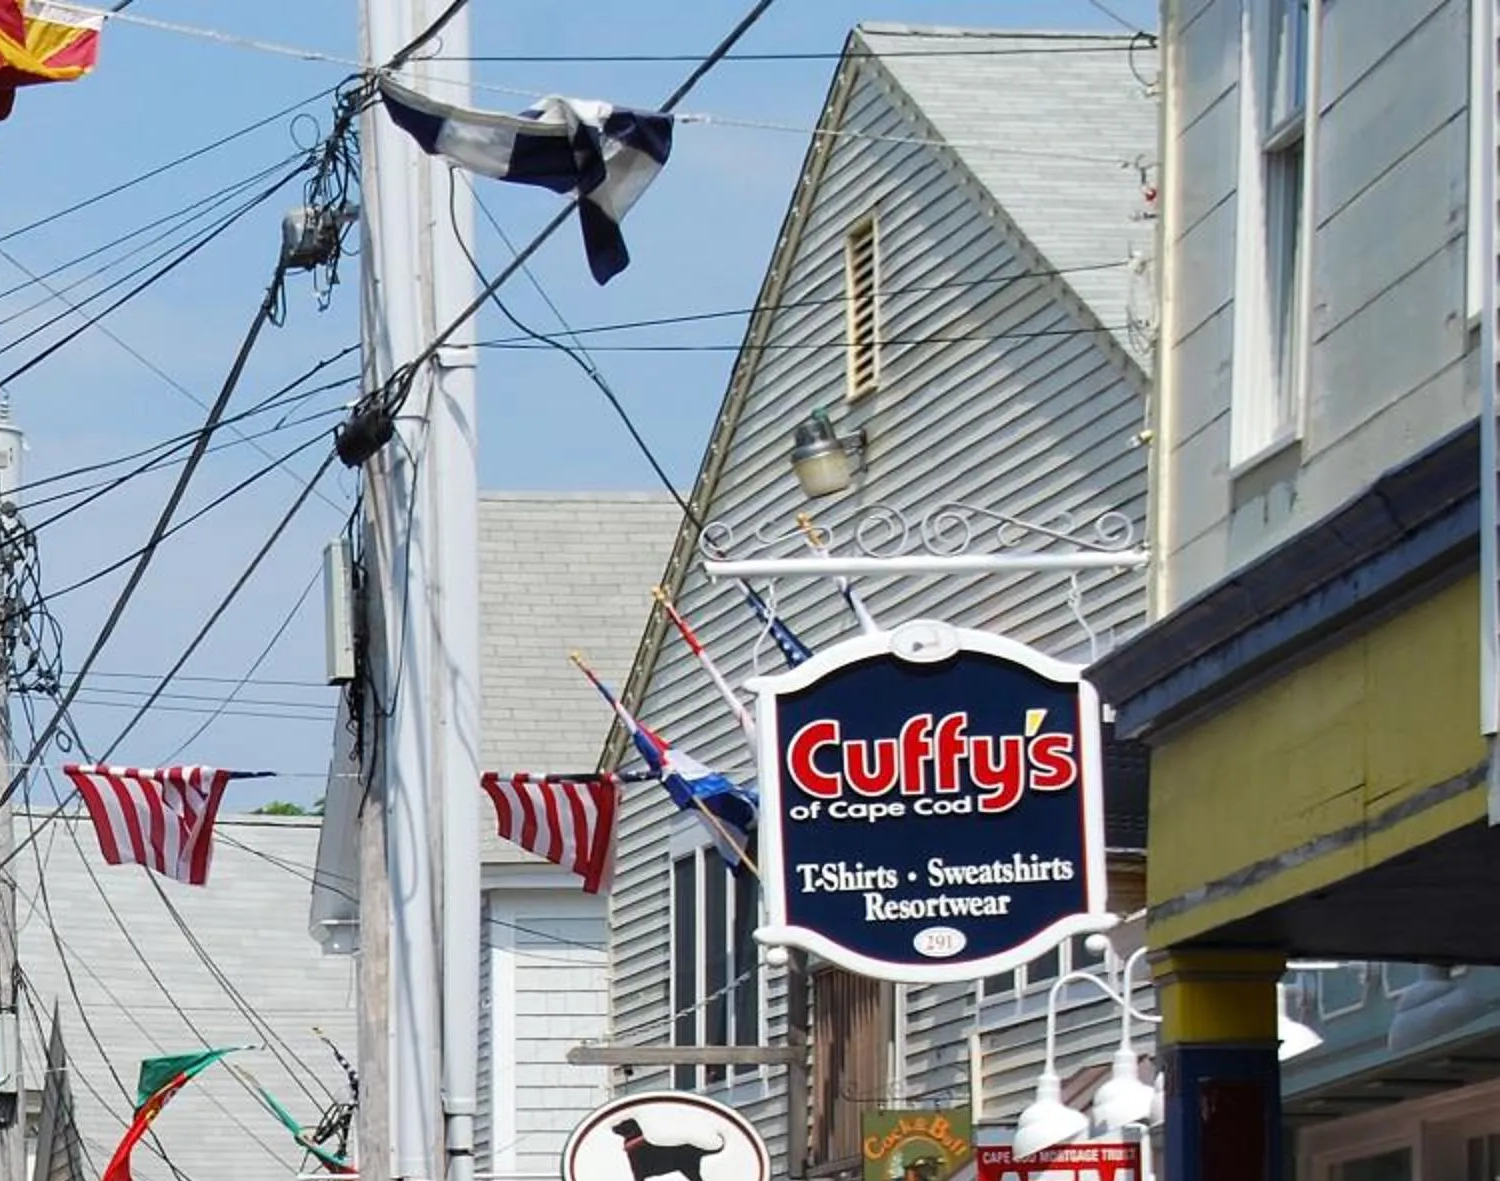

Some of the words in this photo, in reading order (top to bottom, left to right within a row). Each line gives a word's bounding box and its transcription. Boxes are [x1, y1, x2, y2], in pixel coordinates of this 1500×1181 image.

[787, 709, 1077, 812] Cuffy's
[790, 801, 821, 820] of
[828, 801, 905, 822] Cape
[913, 797, 972, 815] Cod
[796, 861, 898, 893] T-Shirts
[927, 853, 1074, 887] Sweatshirts
[863, 892, 1012, 921] Resortwear
[925, 935, 954, 950] 291
[982, 1151, 1011, 1164] CAPE
